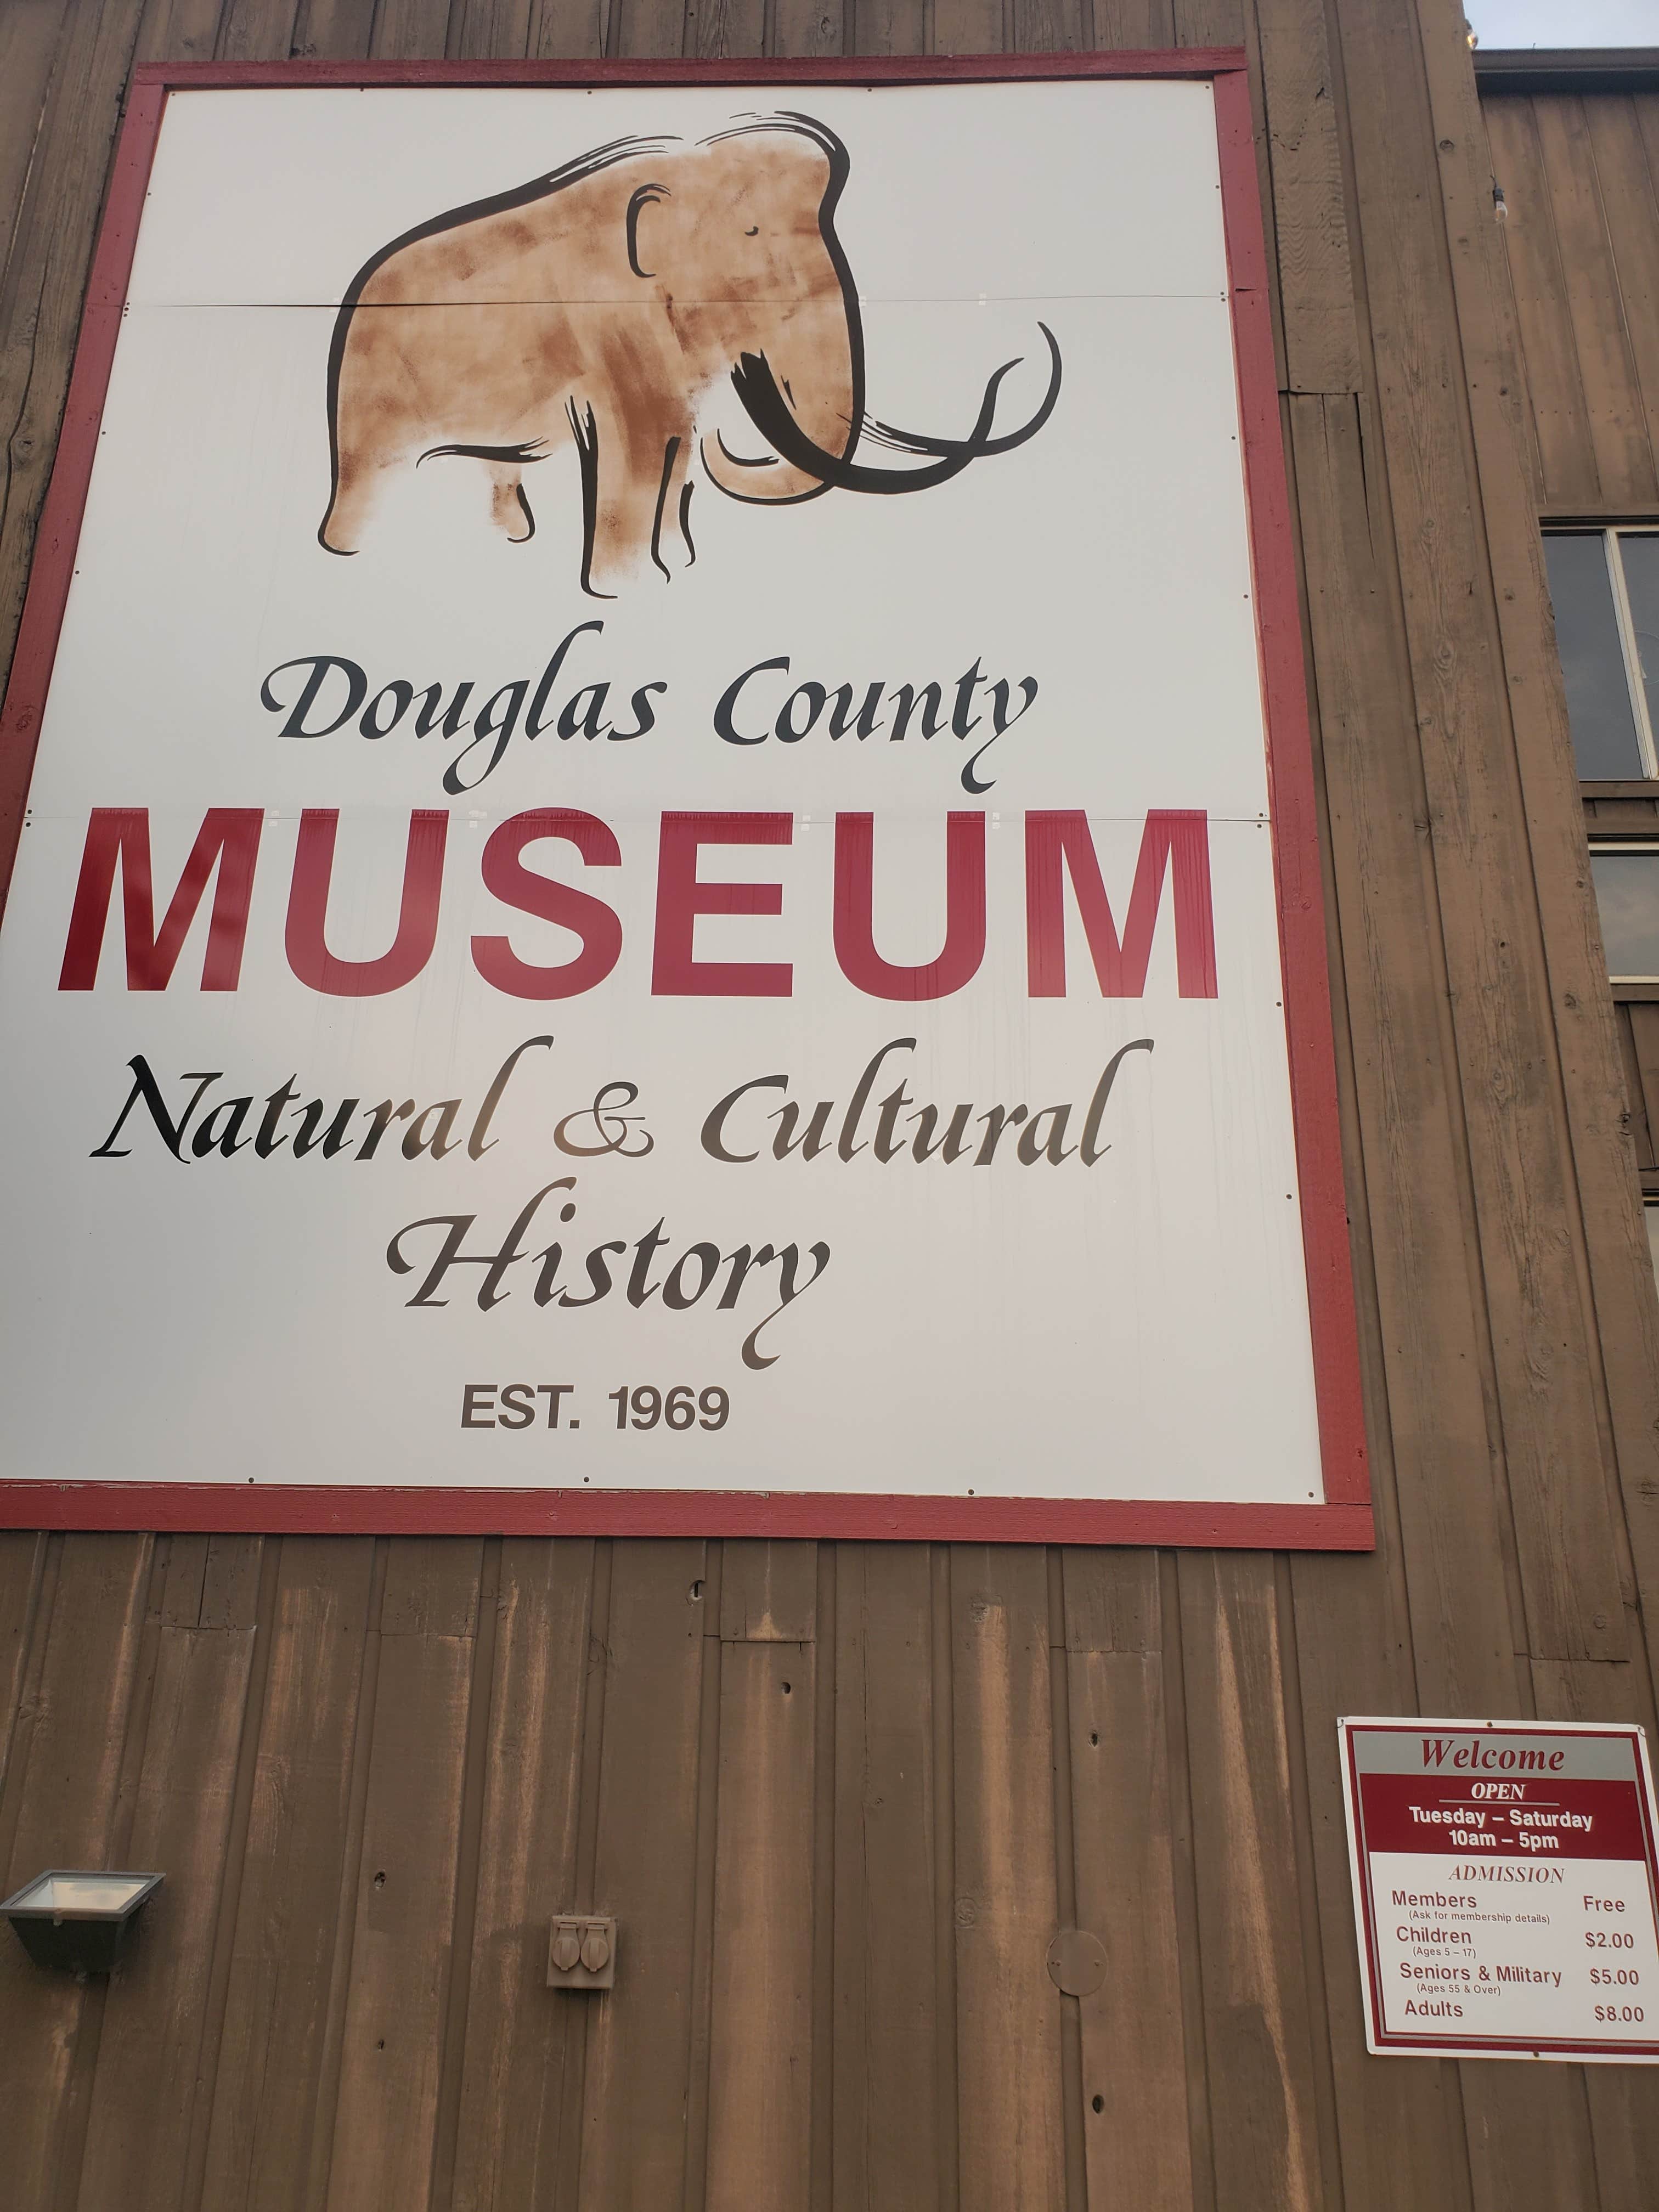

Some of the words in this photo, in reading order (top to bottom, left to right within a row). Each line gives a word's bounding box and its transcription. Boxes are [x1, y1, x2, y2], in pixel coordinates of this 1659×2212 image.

[261, 620, 667, 795] Douglas
[714, 657, 1038, 794] County
[58, 808, 1218, 1001] MUSEUM
[89, 1036, 554, 1164] Natural
[554, 1082, 654, 1157] &
[701, 1038, 1154, 1167] Cultural
[387, 1177, 830, 1370] History
[461, 1384, 579, 1429] EST.
[609, 1386, 729, 1431] 1969
[1421, 1740, 1565, 1771] Welcome
[1471, 1782, 1526, 1800] OPEN
[1409, 1806, 1485, 1828] Tuesday
[1510, 1809, 1593, 1832] Saturday
[1449, 1830, 1496, 1847] 10am
[1519, 1832, 1559, 1852] 5pm
[1448, 1865, 1565, 1883] ADMISSION
[1392, 1890, 1477, 1908] Members
[1583, 1895, 1626, 1912] Free
[1409, 1910, 1431, 1920] (Ask
[1434, 1911, 1448, 1920] for
[1451, 1912, 1511, 1924] membership
[1515, 1914, 1550, 1925] details)
[1396, 1926, 1471, 1944] Children
[1585, 1932, 1634, 1950] $2.00
[1413, 1946, 1442, 1957] (Ages
[1444, 1948, 1450, 1956] 5
[1463, 1948, 1477, 1959] 17)
[1400, 1962, 1471, 1980] Seniors
[1479, 1965, 1491, 1980] &
[1496, 1966, 1562, 1988] Military
[1590, 1968, 1640, 1986] $5.00
[1417, 1983, 1445, 1994] (Ages
[1448, 1984, 1460, 1993] 55
[1464, 1985, 1471, 1994] &
[1474, 1985, 1501, 1996] Over)
[1404, 2000, 1464, 2017] Adults
[1594, 2005, 1645, 2023] $8.00
